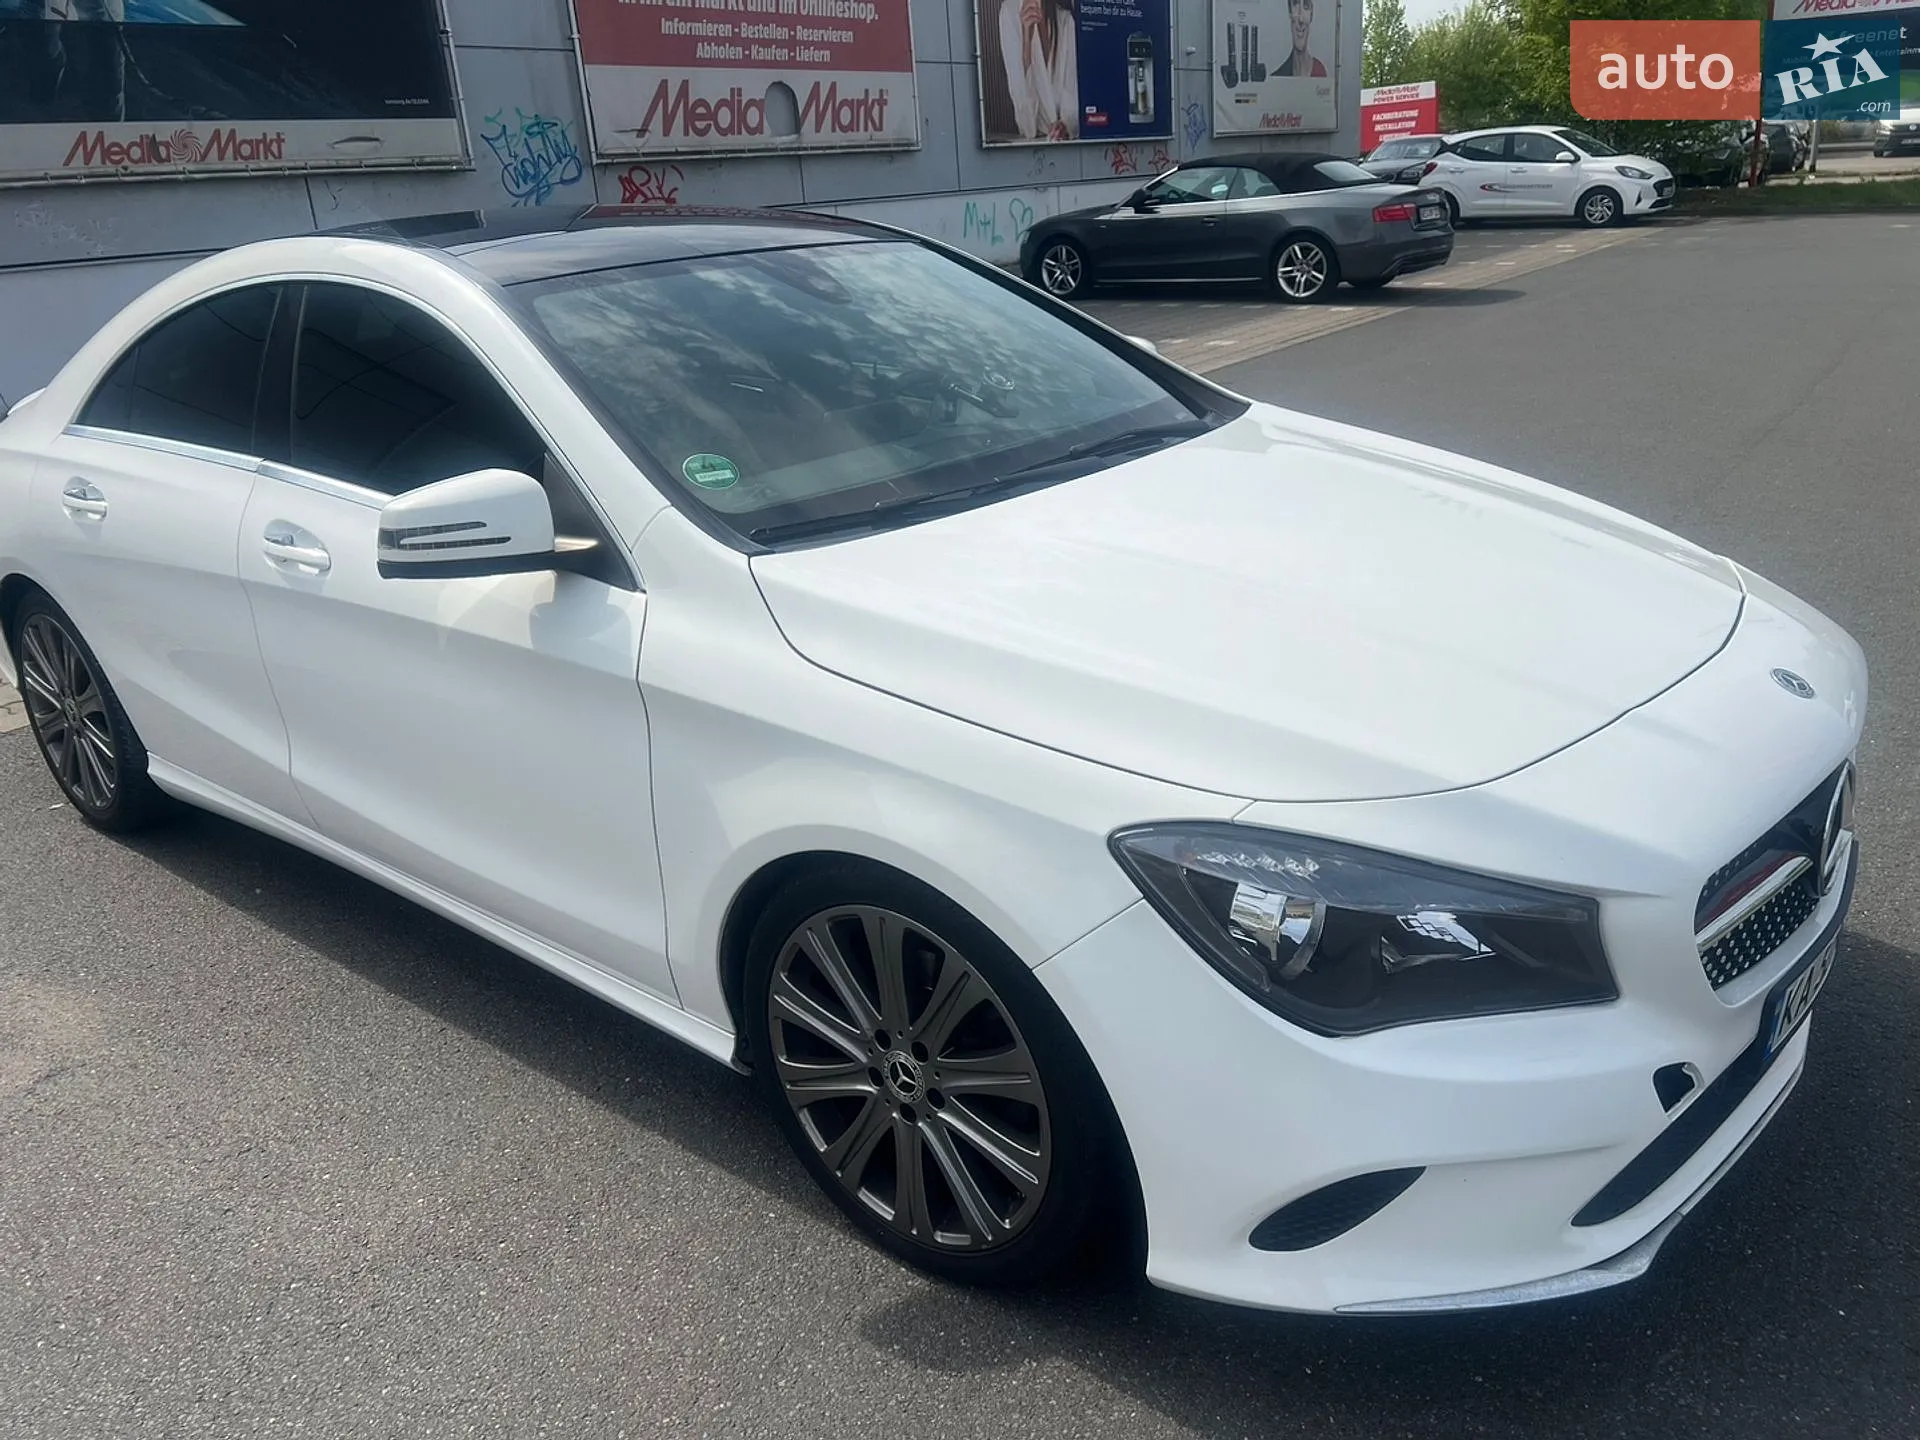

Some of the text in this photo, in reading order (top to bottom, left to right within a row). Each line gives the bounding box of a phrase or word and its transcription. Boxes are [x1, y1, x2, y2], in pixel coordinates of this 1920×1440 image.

[799, 0, 879, 23] Onlineshop.
[661, 18, 854, 43] Informieren Bestellen Reservieren
[696, 43, 830, 62] Abholen Kaufen Liefern
[636, 78, 888, 138] Media Markt
[1395, 92, 1420, 101] SERVICE
[63, 127, 285, 166] Media Markt
